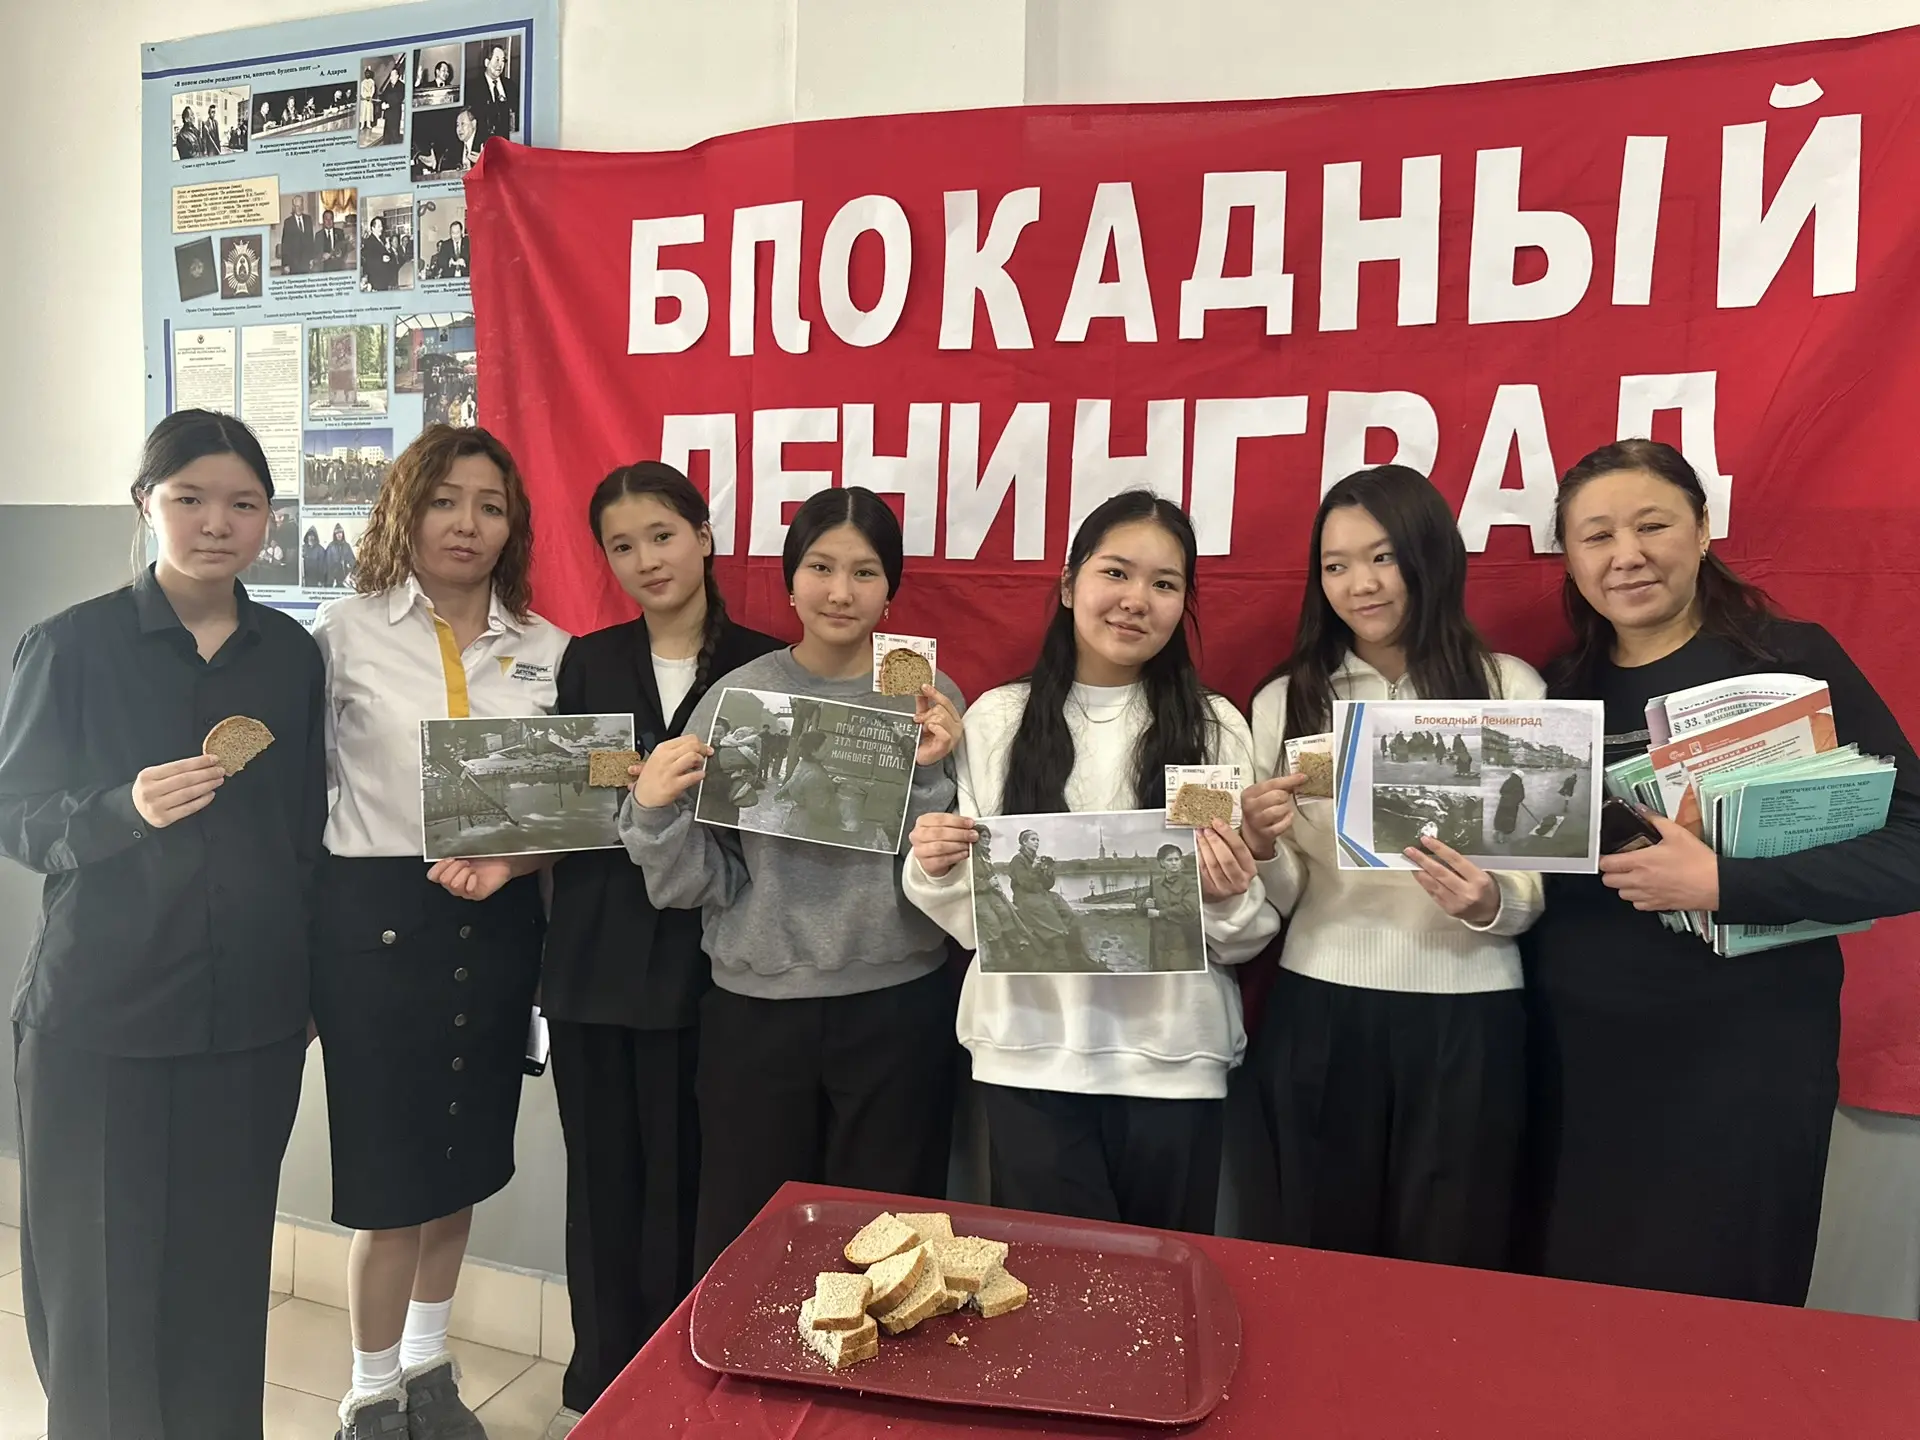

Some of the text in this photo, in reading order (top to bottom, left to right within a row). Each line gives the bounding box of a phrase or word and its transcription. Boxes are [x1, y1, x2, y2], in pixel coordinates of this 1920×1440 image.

[278, 68, 298, 76] будешь
[626, 78, 1862, 356] БЛОКАДНЫЙ
[660, 370, 1733, 560] ЛЕНИНГРАД
[1414, 714, 1542, 728] Блокадный Ленинград
[1684, 717, 1701, 728] 33.
[878, 754, 909, 771] ОПАС
[1220, 782, 1238, 790] ХЛЕБ
[1780, 785, 1826, 794] МЕТРИЧЕСКАЯ
[1826, 782, 1856, 790] СИСТЕМА
[1784, 828, 1814, 836] ТАБЛИЦА
